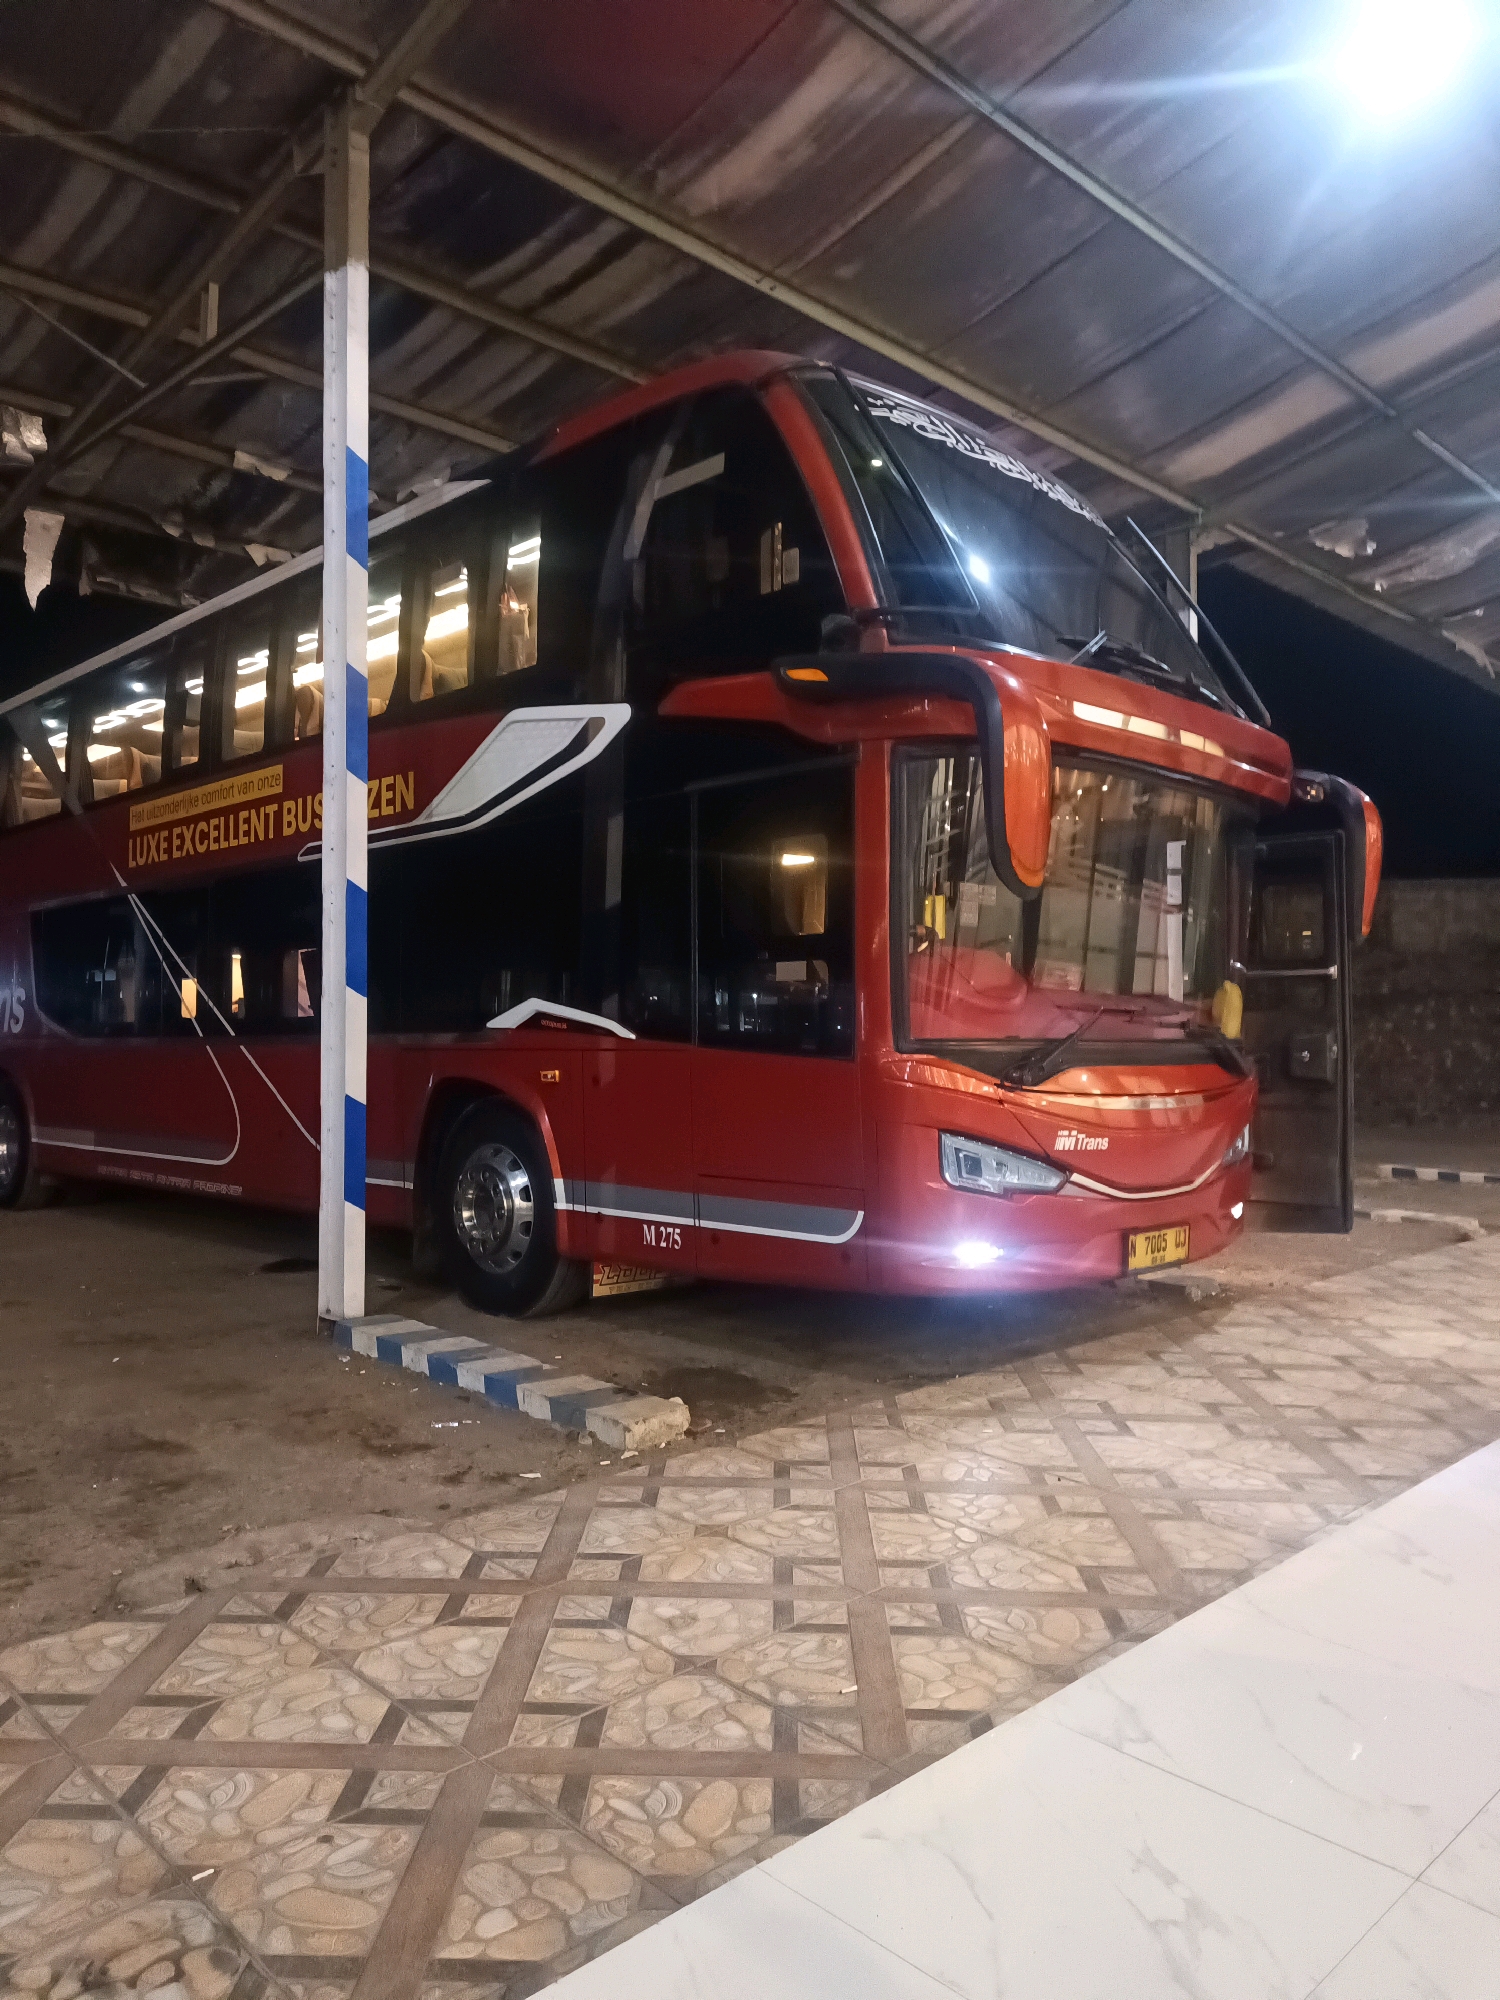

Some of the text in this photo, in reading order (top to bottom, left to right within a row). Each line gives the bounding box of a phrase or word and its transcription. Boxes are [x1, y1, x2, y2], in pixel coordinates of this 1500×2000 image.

[131, 772, 281, 826] Het uitzonderlijke comfort van onze
[128, 829, 169, 869] LUXE
[172, 803, 279, 859] EXCELLENT
[643, 1223, 682, 1250] M 275
[1130, 1228, 1187, 1258] N 7005 UJ
